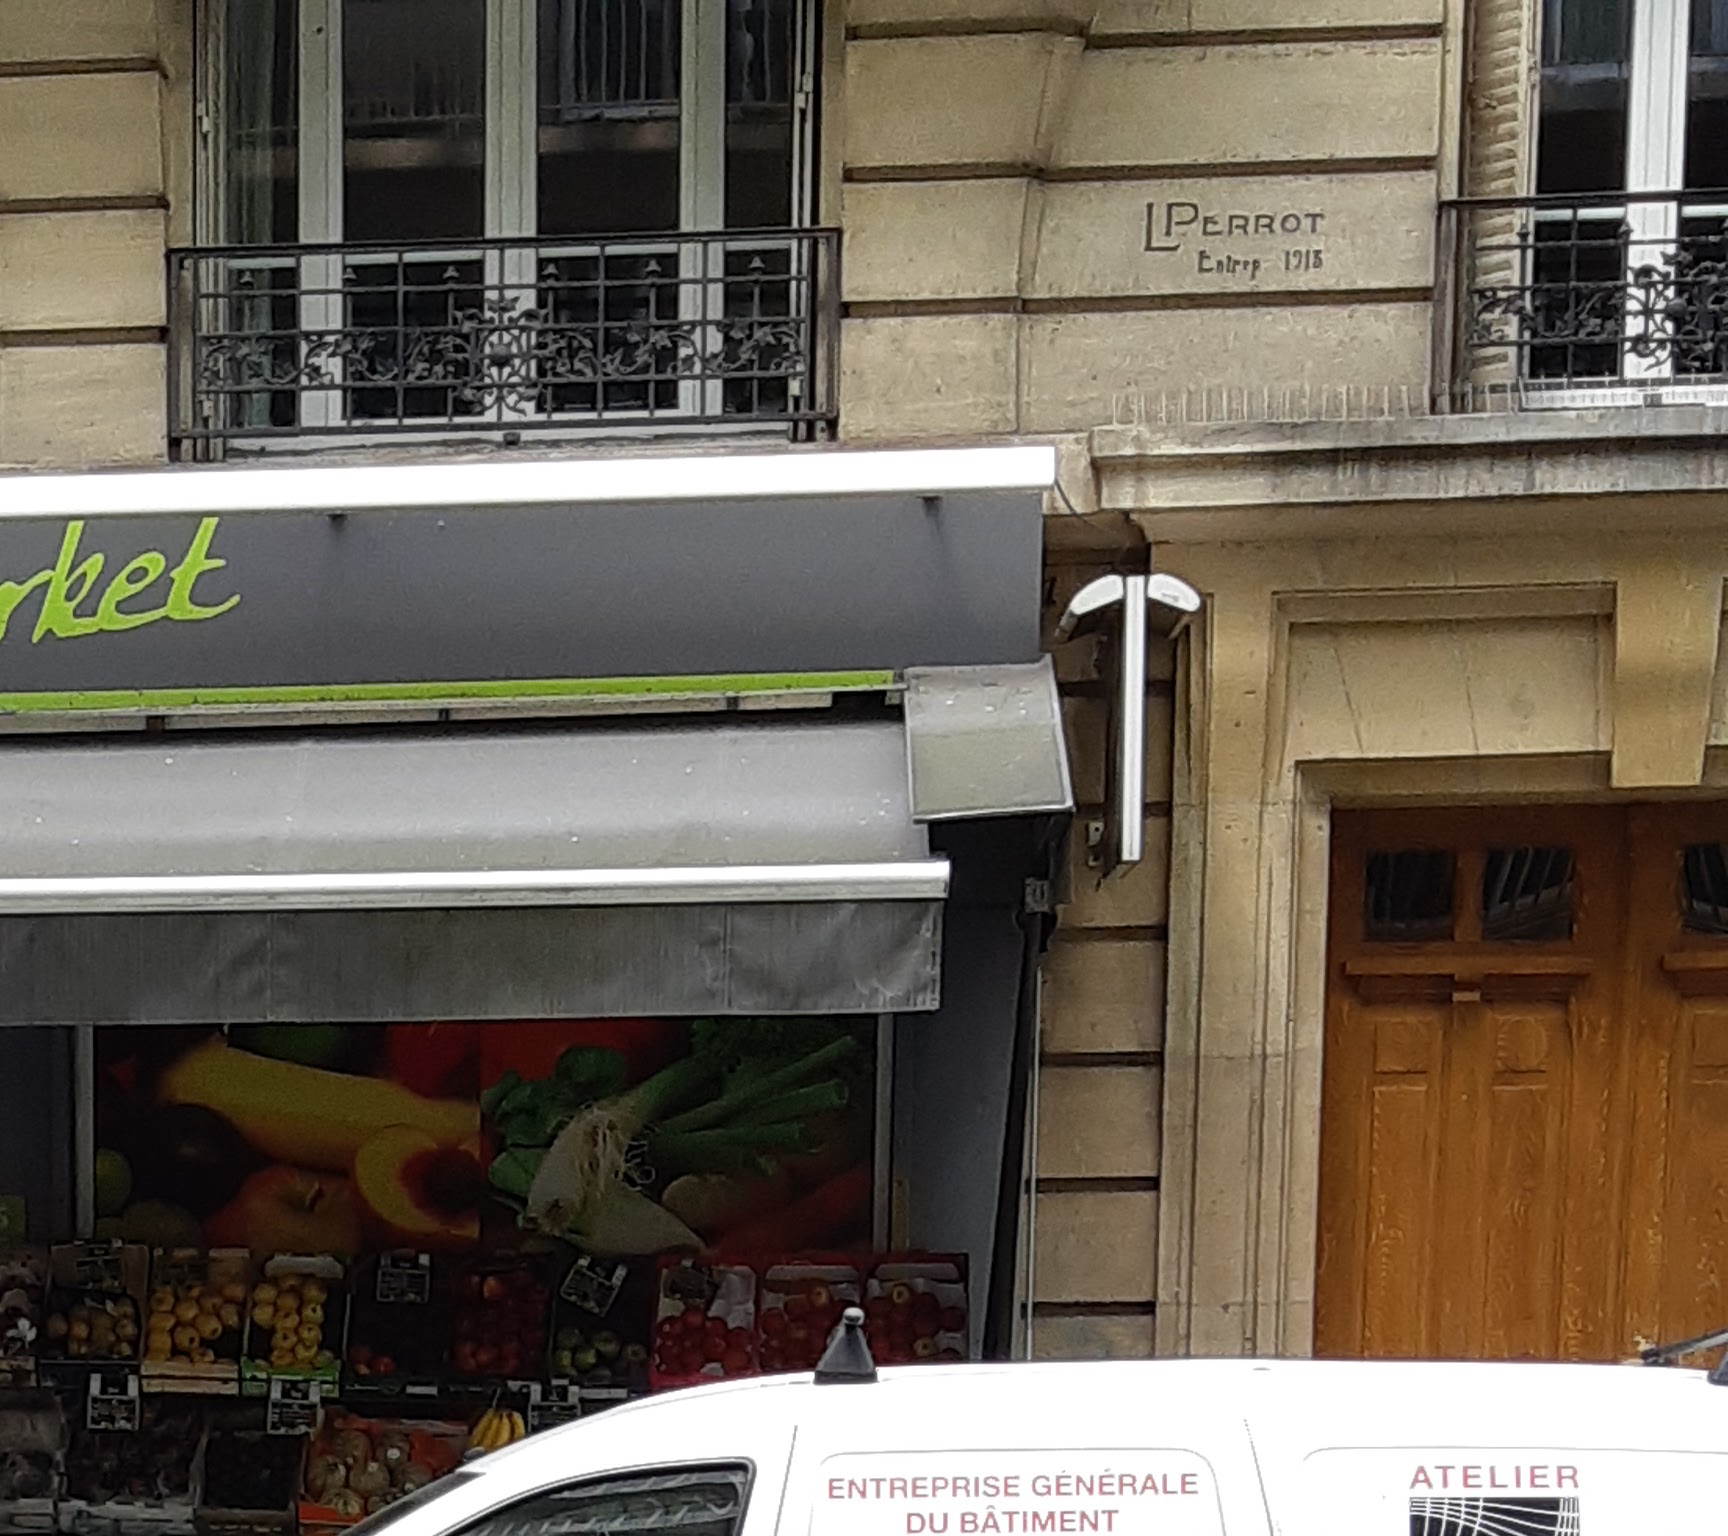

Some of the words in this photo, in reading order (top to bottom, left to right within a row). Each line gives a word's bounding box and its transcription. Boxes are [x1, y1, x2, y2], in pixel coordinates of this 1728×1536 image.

[828, 1476, 1021, 1500] ENTREPRISE
[1031, 1468, 1199, 1496] GÉNÉRALE
[1409, 1465, 1579, 1489] ATELIER
[906, 1512, 948, 1534] DU
[960, 1505, 1119, 1534] BÂTIMENT
